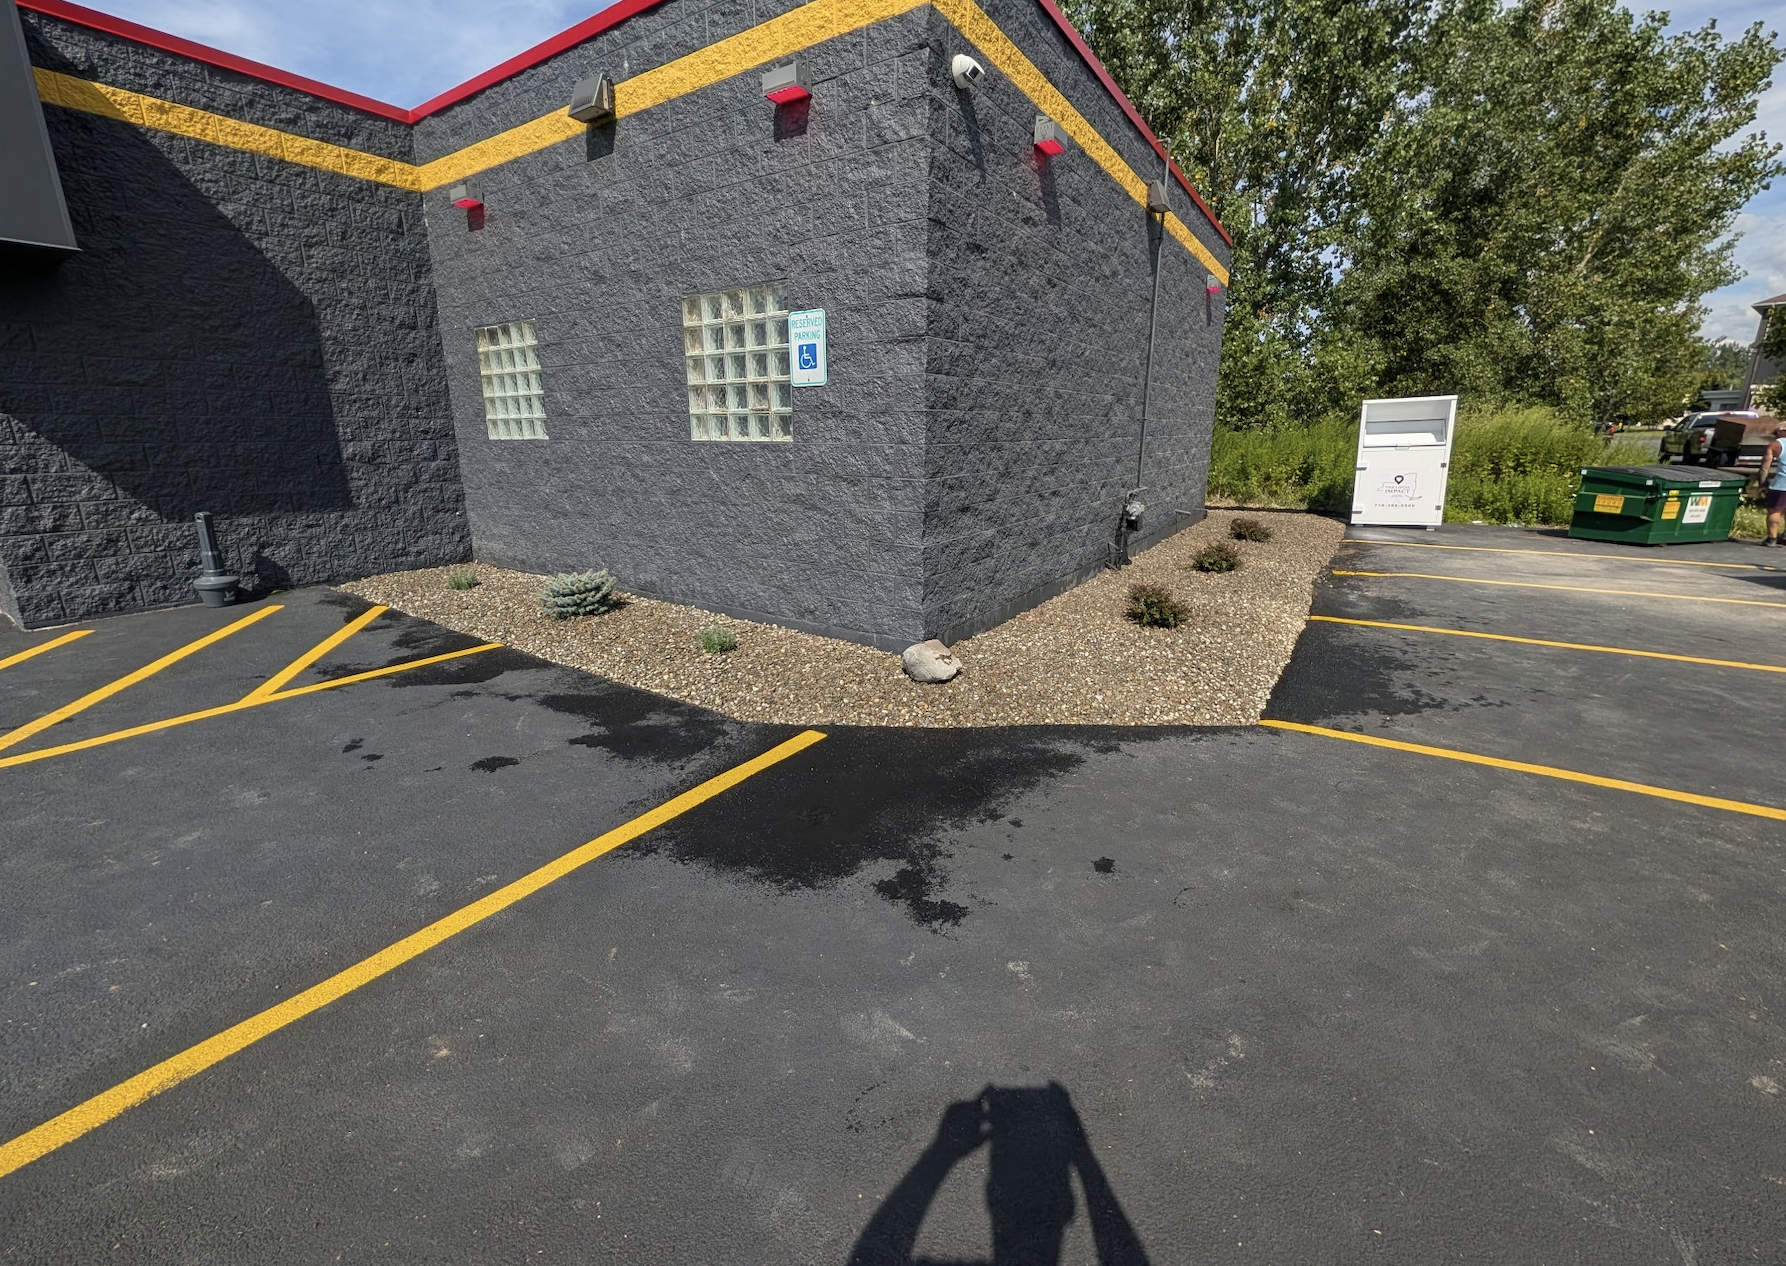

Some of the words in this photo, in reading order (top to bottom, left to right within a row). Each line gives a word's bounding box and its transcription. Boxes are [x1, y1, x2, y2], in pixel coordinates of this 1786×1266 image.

[791, 317, 823, 329] RESERVED
[794, 330, 821, 341] PARKING
[1690, 496, 1708, 506] WM
